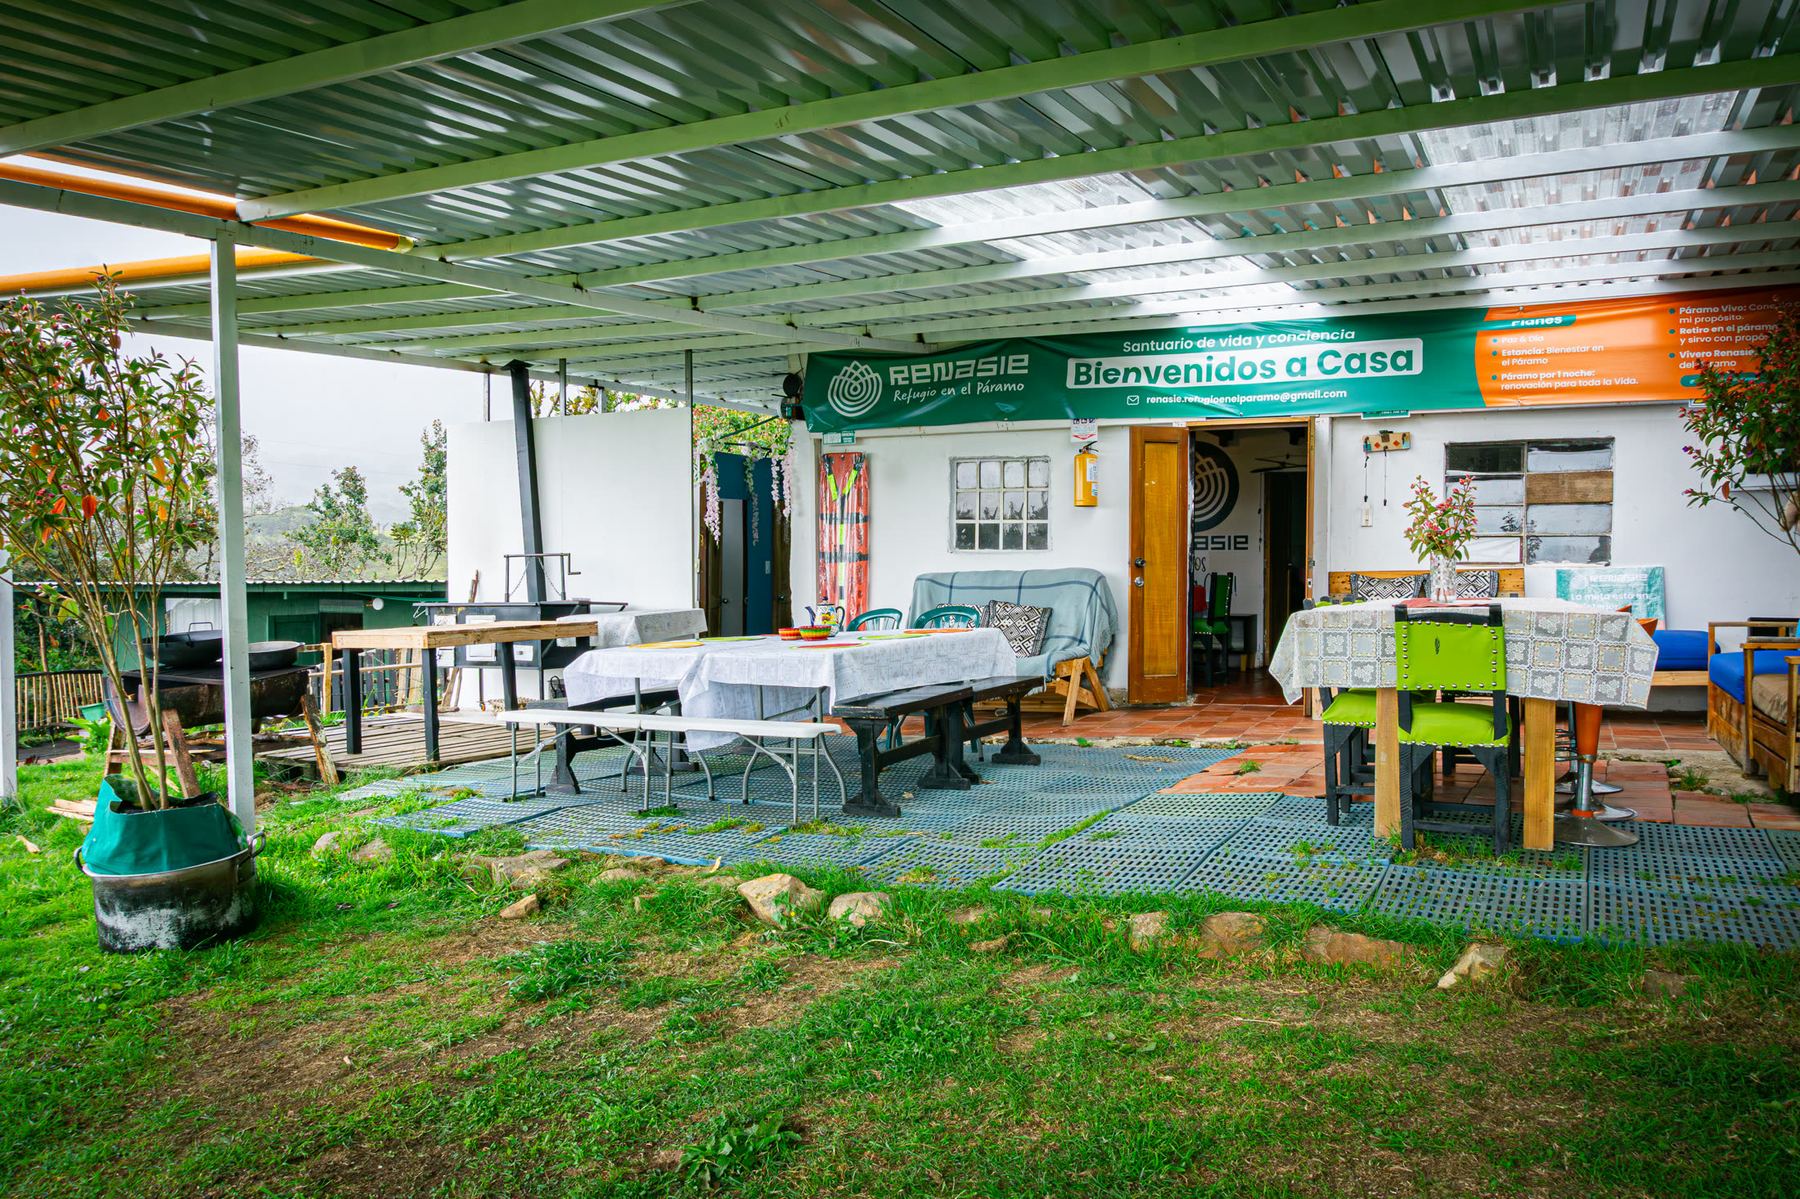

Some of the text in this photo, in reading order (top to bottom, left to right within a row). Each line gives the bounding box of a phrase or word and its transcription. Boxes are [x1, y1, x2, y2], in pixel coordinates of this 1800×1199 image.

[1680, 306, 1720, 314] Páramo
[1694, 315, 1744, 324] propósito.
[1123, 329, 1356, 352] Santuario de vida y conciencia
[1502, 347, 1544, 356] Estancia:
[1546, 345, 1590, 354] Bienestar
[1512, 357, 1548, 366] Páramo
[1679, 361, 1694, 369] del
[1074, 350, 1414, 386] Bienvenidos a Casa
[1501, 372, 1538, 380] Páramo
[1540, 372, 1554, 381] por
[1563, 370, 1596, 378] noche:
[1501, 381, 1552, 390] renovación
[1554, 380, 1578, 390] para
[1579, 378, 1600, 386] toda
[1614, 377, 1639, 385] Vida.
[894, 380, 1024, 404] Refugio en el Páramo
[1146, 390, 1347, 406] renasie.refugioenelparamo@gmail.com
